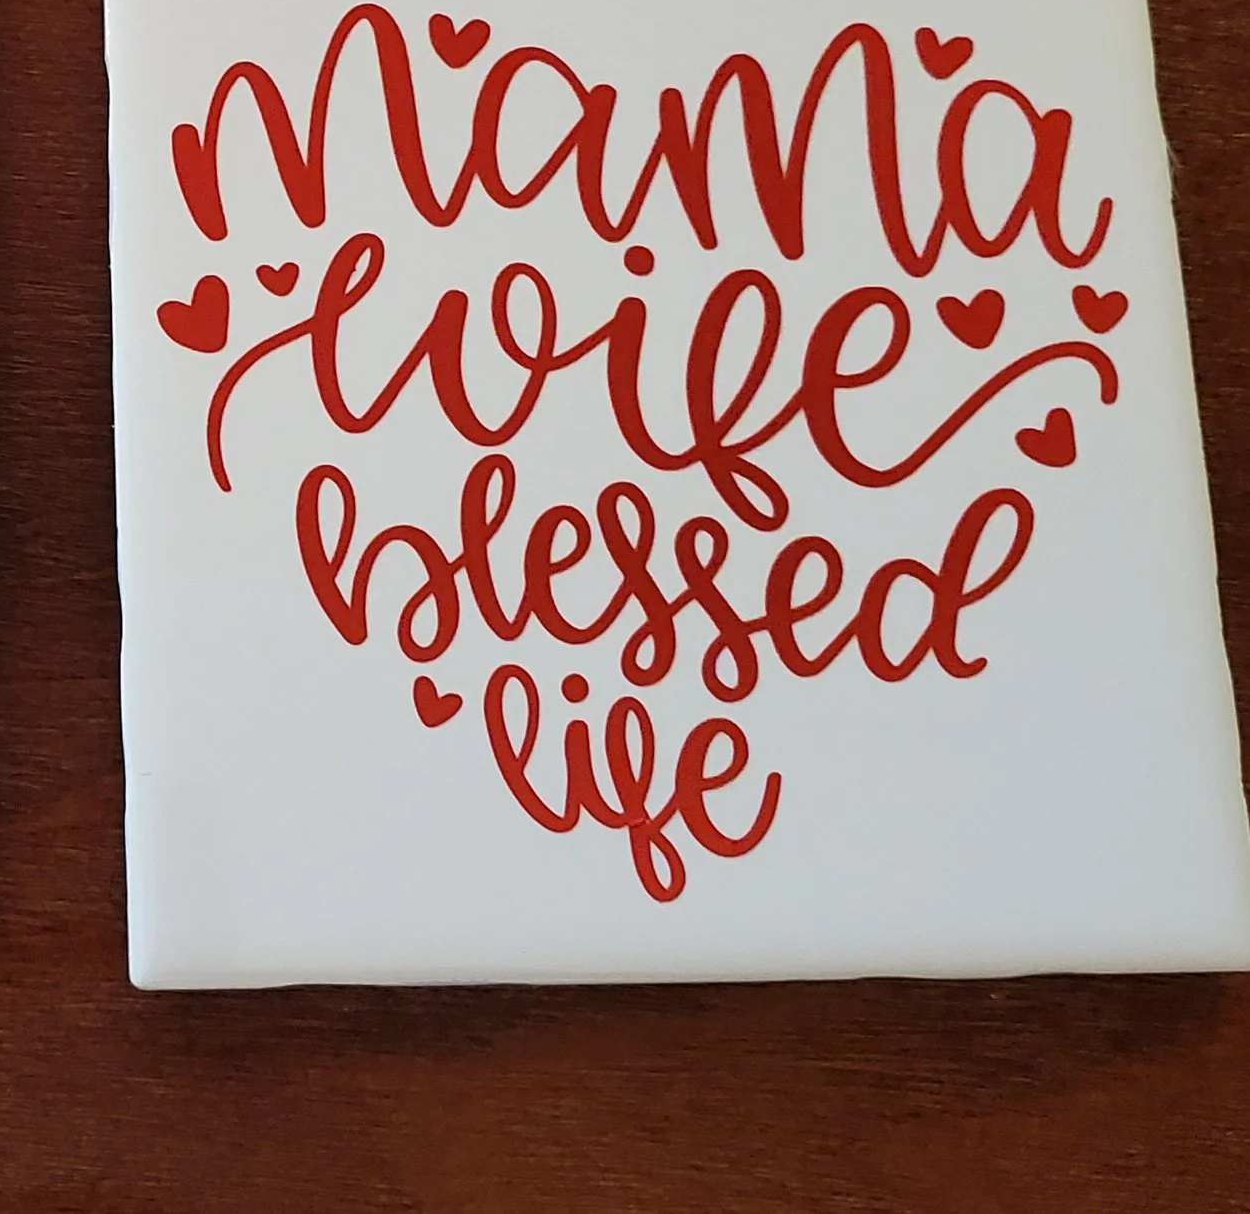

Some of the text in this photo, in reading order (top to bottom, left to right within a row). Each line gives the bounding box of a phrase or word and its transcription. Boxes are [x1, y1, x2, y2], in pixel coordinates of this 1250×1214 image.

[206, 231, 1119, 533] wife
[295, 452, 1035, 704] blessed
[483, 662, 783, 903] life
